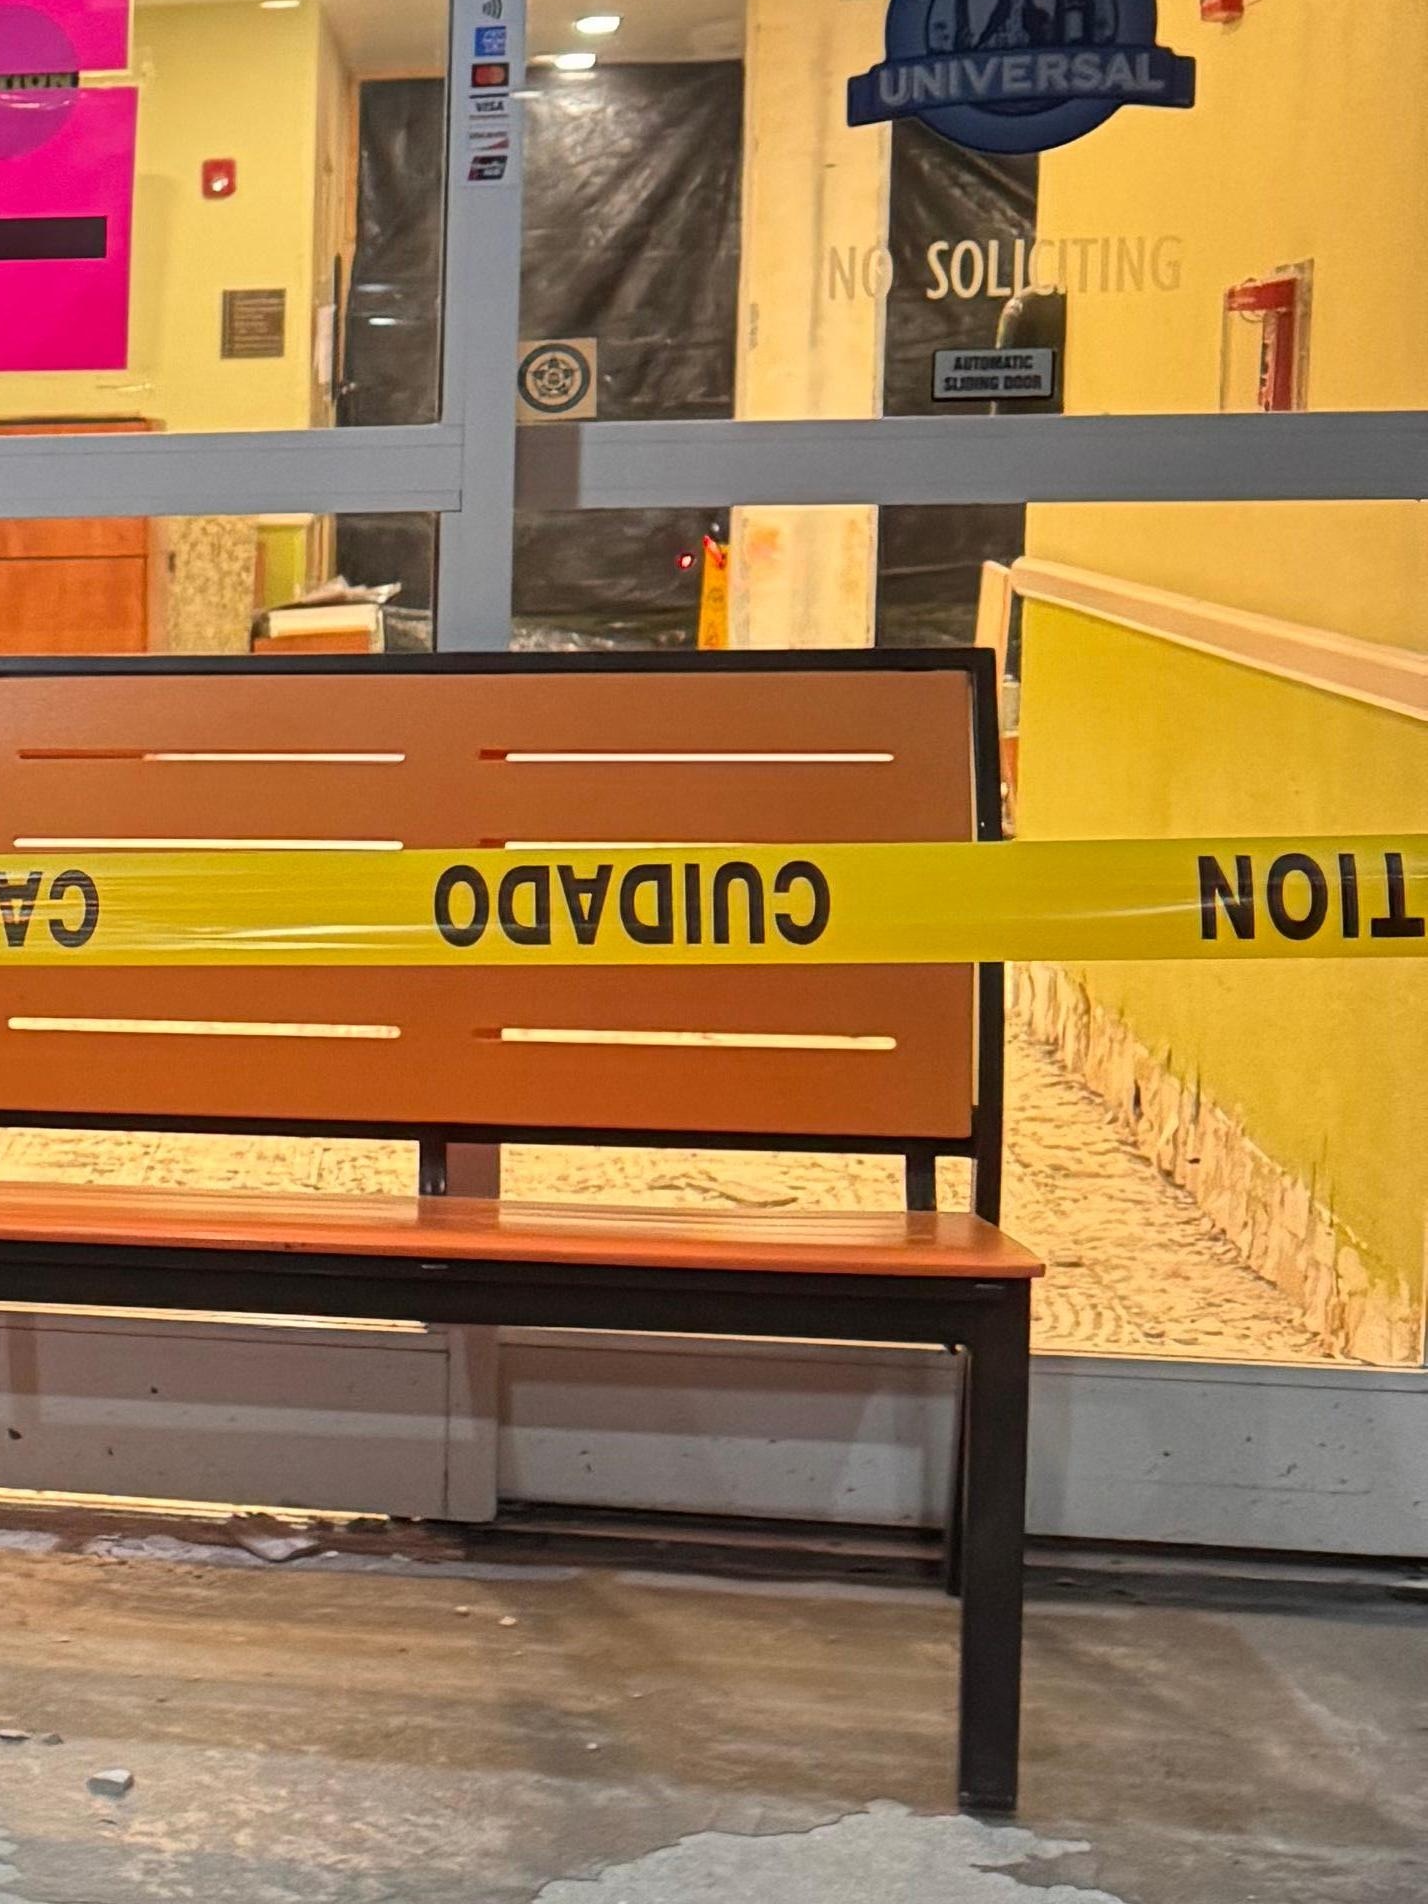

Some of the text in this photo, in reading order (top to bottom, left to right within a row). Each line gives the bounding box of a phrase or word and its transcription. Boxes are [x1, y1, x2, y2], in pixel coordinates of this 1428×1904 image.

[878, 51, 1166, 106] UNIVERSAL
[828, 234, 1184, 301] NO SOLICITING
[953, 355, 1034, 371] AUTOMATIC
[433, 860, 831, 947] CUIDADO
